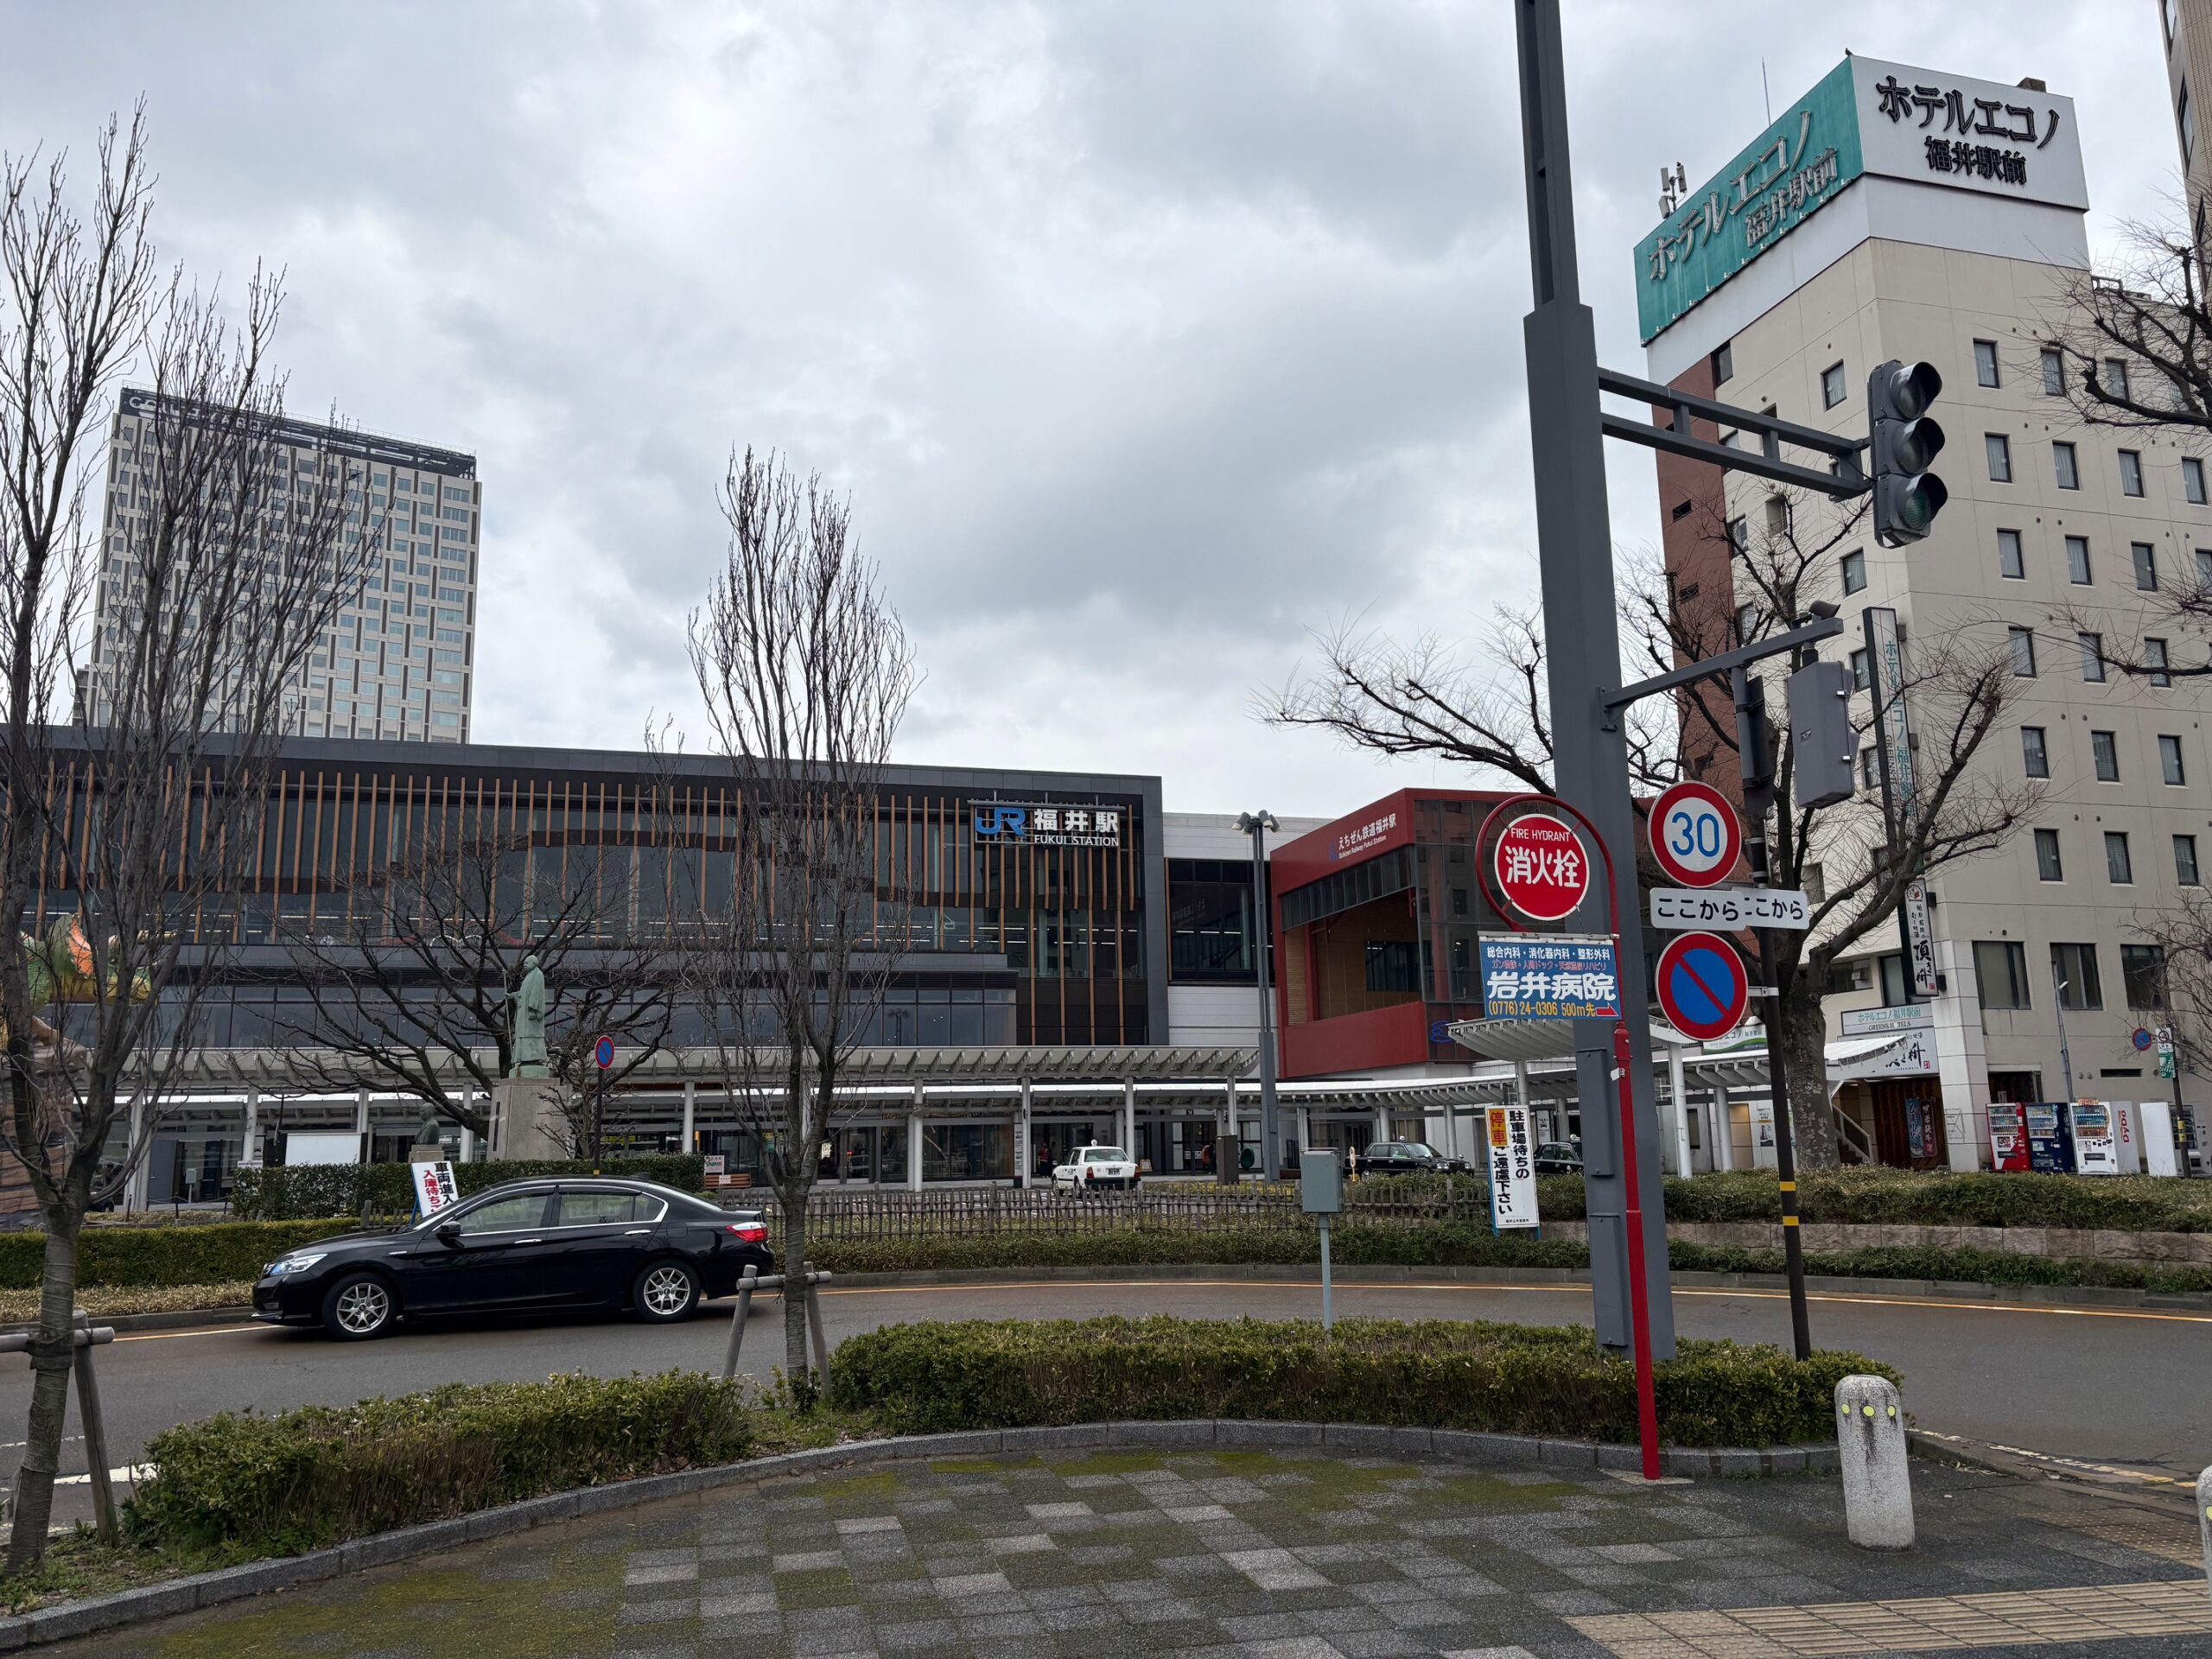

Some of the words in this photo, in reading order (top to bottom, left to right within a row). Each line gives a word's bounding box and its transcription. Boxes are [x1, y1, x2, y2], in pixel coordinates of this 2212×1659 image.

[1875, 75, 2061, 149] ホテルエコノ
[1924, 135, 2027, 185] 福井駅前
[1649, 111, 1812, 282] ホテルエコノ
[1745, 146, 1839, 249] 福井駅前
[975, 807, 1026, 836] JR
[1033, 808, 1119, 834] 福井駅
[1338, 812, 1397, 851] えちぜん鉄道福井駅
[1510, 828, 1529, 840] FIRE
[1532, 830, 1571, 842] HYDRANT
[1672, 811, 1719, 857] 30
[1034, 835, 1068, 844] FUKUI
[1072, 836, 1119, 847] STATION
[1373, 835, 1387, 845] Station
[1504, 845, 1581, 888] 消火栓
[1657, 897, 1738, 922] ここから
[1487, 971, 1617, 1001] 岩井病院
[1561, 1002, 1597, 1018] 500m先
[1868, 1022, 1889, 1031] GREENS
[1510, 1110, 1530, 1179] 駐車場待ちの
[434, 1162, 454, 1205] 車両進入
